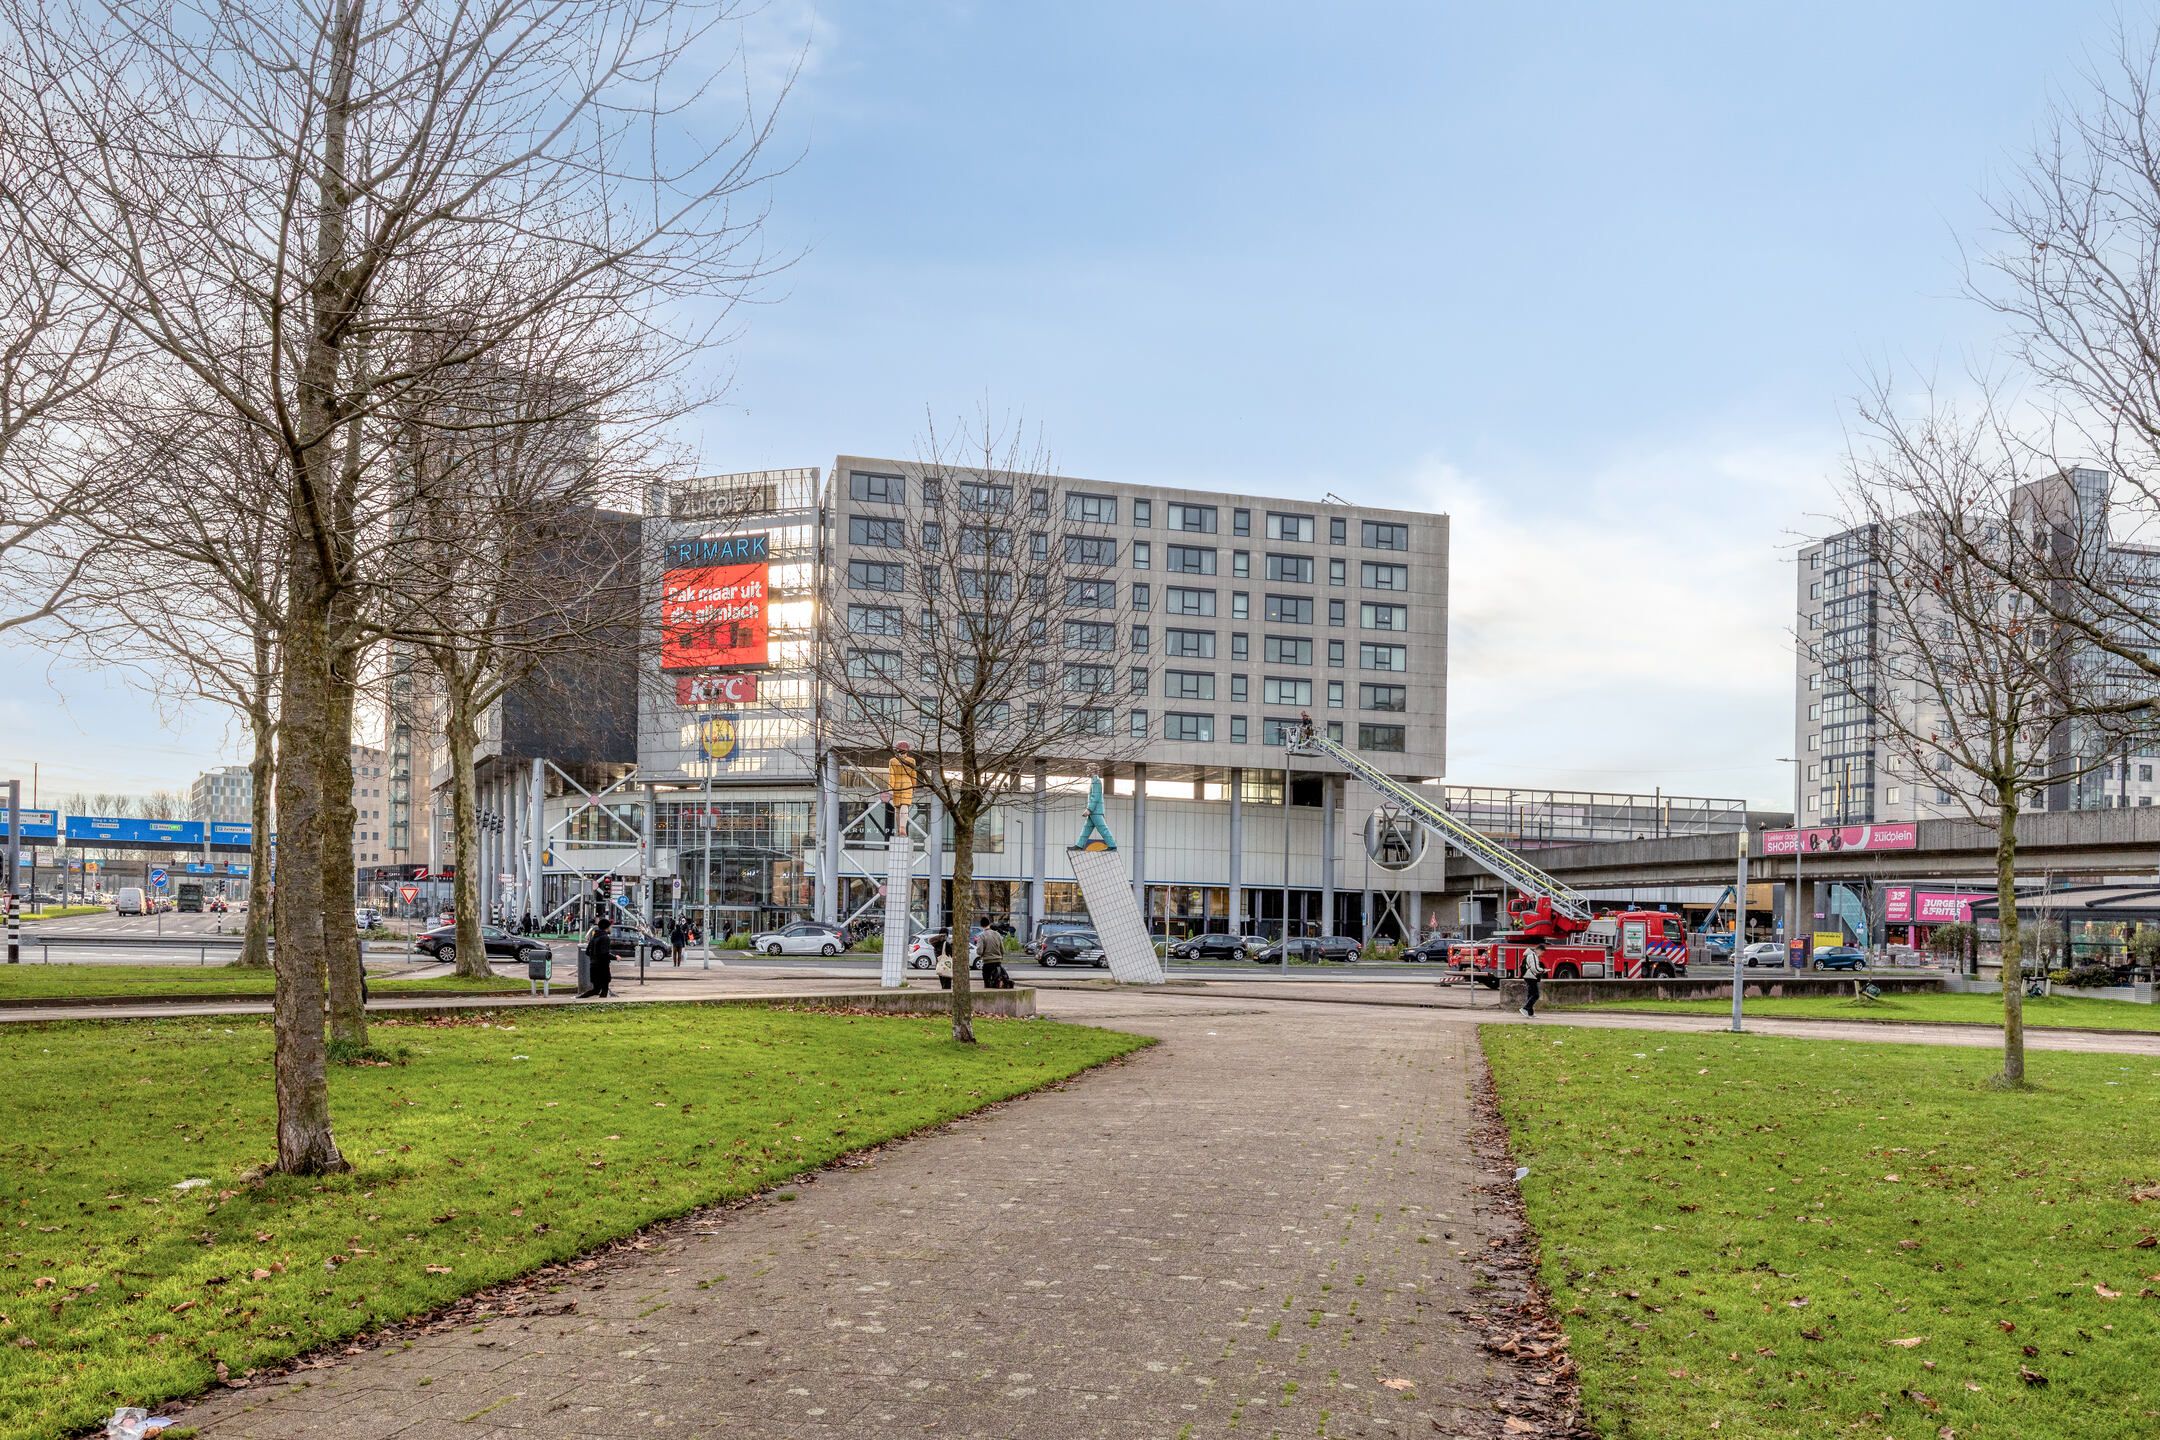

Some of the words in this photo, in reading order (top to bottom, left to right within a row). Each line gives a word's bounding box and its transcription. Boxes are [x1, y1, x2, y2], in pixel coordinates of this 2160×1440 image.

[665, 537, 766, 562] PRIMARK
[668, 587, 695, 604] Pak
[698, 586, 738, 602] maar
[740, 581, 762, 599] uit
[695, 602, 759, 624] glimlach
[689, 677, 744, 702] KFC
[1767, 840, 1805, 852] SHOPPEN
[1874, 830, 1912, 844] zuidplein
